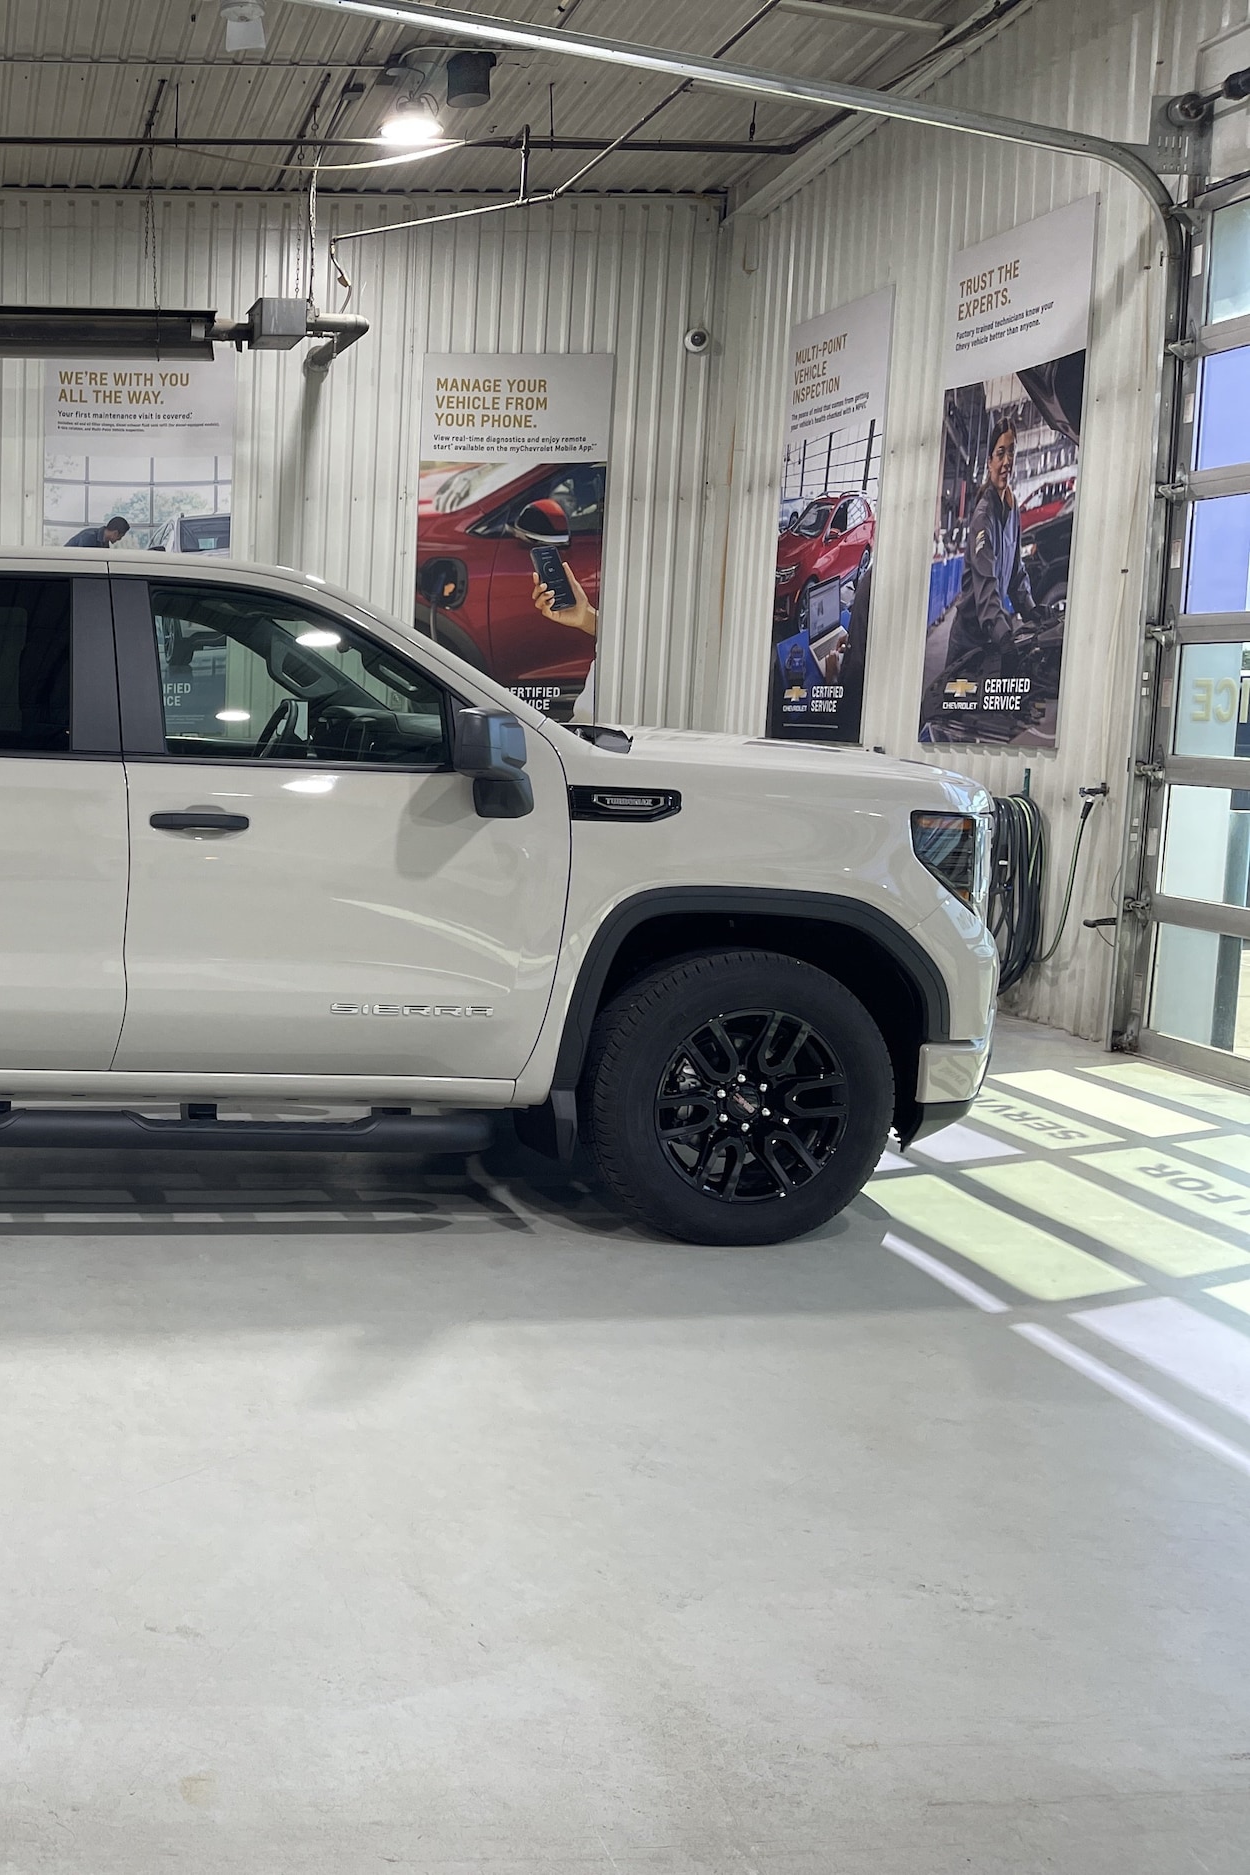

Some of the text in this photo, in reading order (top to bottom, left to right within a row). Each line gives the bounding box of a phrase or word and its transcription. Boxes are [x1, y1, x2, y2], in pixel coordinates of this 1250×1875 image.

[959, 259, 1020, 298] TRUST THE
[957, 287, 1011, 321] EXPERTS.
[956, 301, 1054, 340] Factory trained technicians know your
[955, 318, 1041, 351] Chevy vehicle better than anyone.
[795, 333, 848, 366] MULTI-POINT
[59, 370, 190, 387] WE'RE WITH YOU
[794, 360, 828, 385] VEHICLE
[436, 377, 548, 393] MANAGE YOUR
[792, 375, 841, 405] INSPECTION
[58, 389, 164, 405] ALL THE WAY.
[435, 395, 548, 411] VEHICLE FROM
[58, 410, 74, 418] Your
[92, 412, 137, 420] maintenance
[434, 412, 537, 428] YOUR PHONE.
[433, 434, 451, 442] View
[452, 434, 485, 443] real-time
[486, 435, 525, 444] diagnostics
[541, 436, 560, 445] enjoy
[454, 444, 485, 452] available
[496, 444, 508, 452] the
[509, 444, 553, 453] myChevrolet
[554, 444, 578, 452] Mobile
[163, 683, 191, 694] IFIED
[504, 686, 560, 698] ERTIFIED
[812, 686, 844, 698] CERTIFIED
[985, 678, 1031, 693] CERTIFIED
[811, 700, 838, 712] SERVICE
[942, 702, 978, 710] CHEVROLET
[983, 695, 1021, 710] SERVICE
[605, 797, 654, 806] TURBOMAX
[330, 1002, 494, 1017] SIERRA
[1138, 1163, 1247, 1204] FOR
